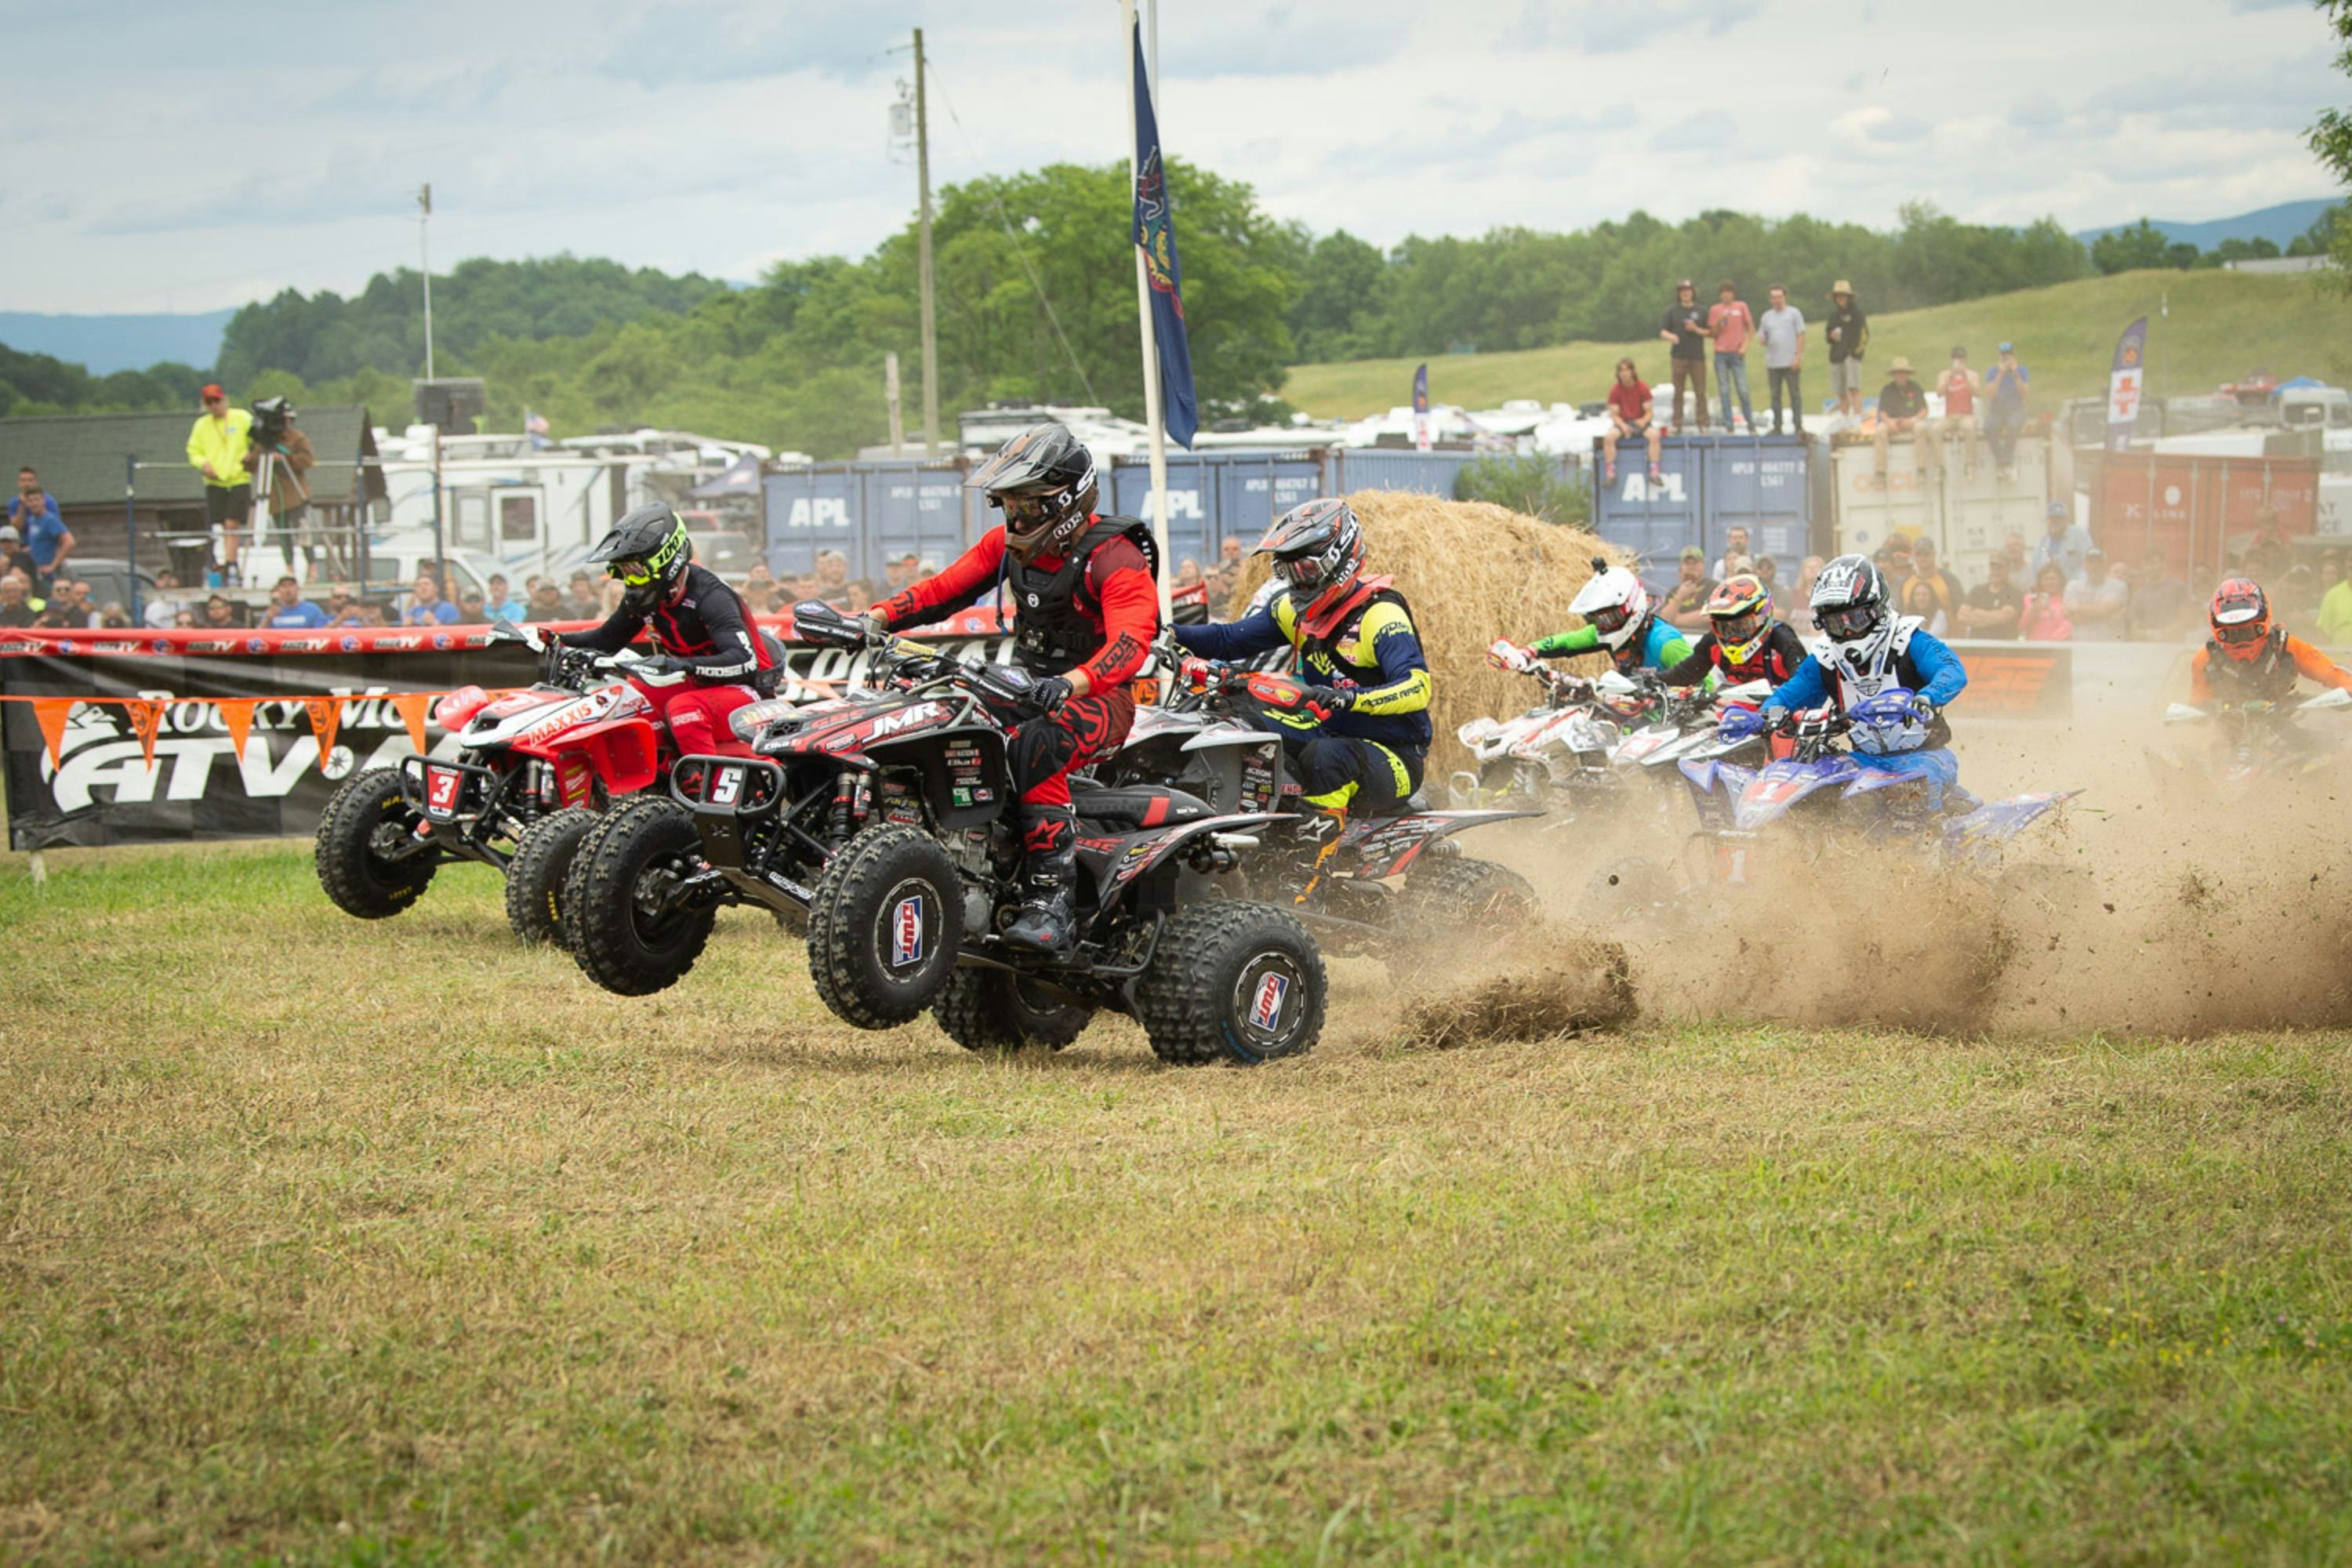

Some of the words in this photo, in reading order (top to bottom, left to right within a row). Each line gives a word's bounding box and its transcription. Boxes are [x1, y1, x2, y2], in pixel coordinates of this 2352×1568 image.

[1621, 474, 1687, 502] APL
[789, 499, 850, 527] APL
[1140, 490, 1206, 519] APL
[528, 702, 593, 748] MAXXIS
[861, 701, 940, 745] JMR
[432, 775, 455, 804] 3
[713, 767, 742, 804] 5
